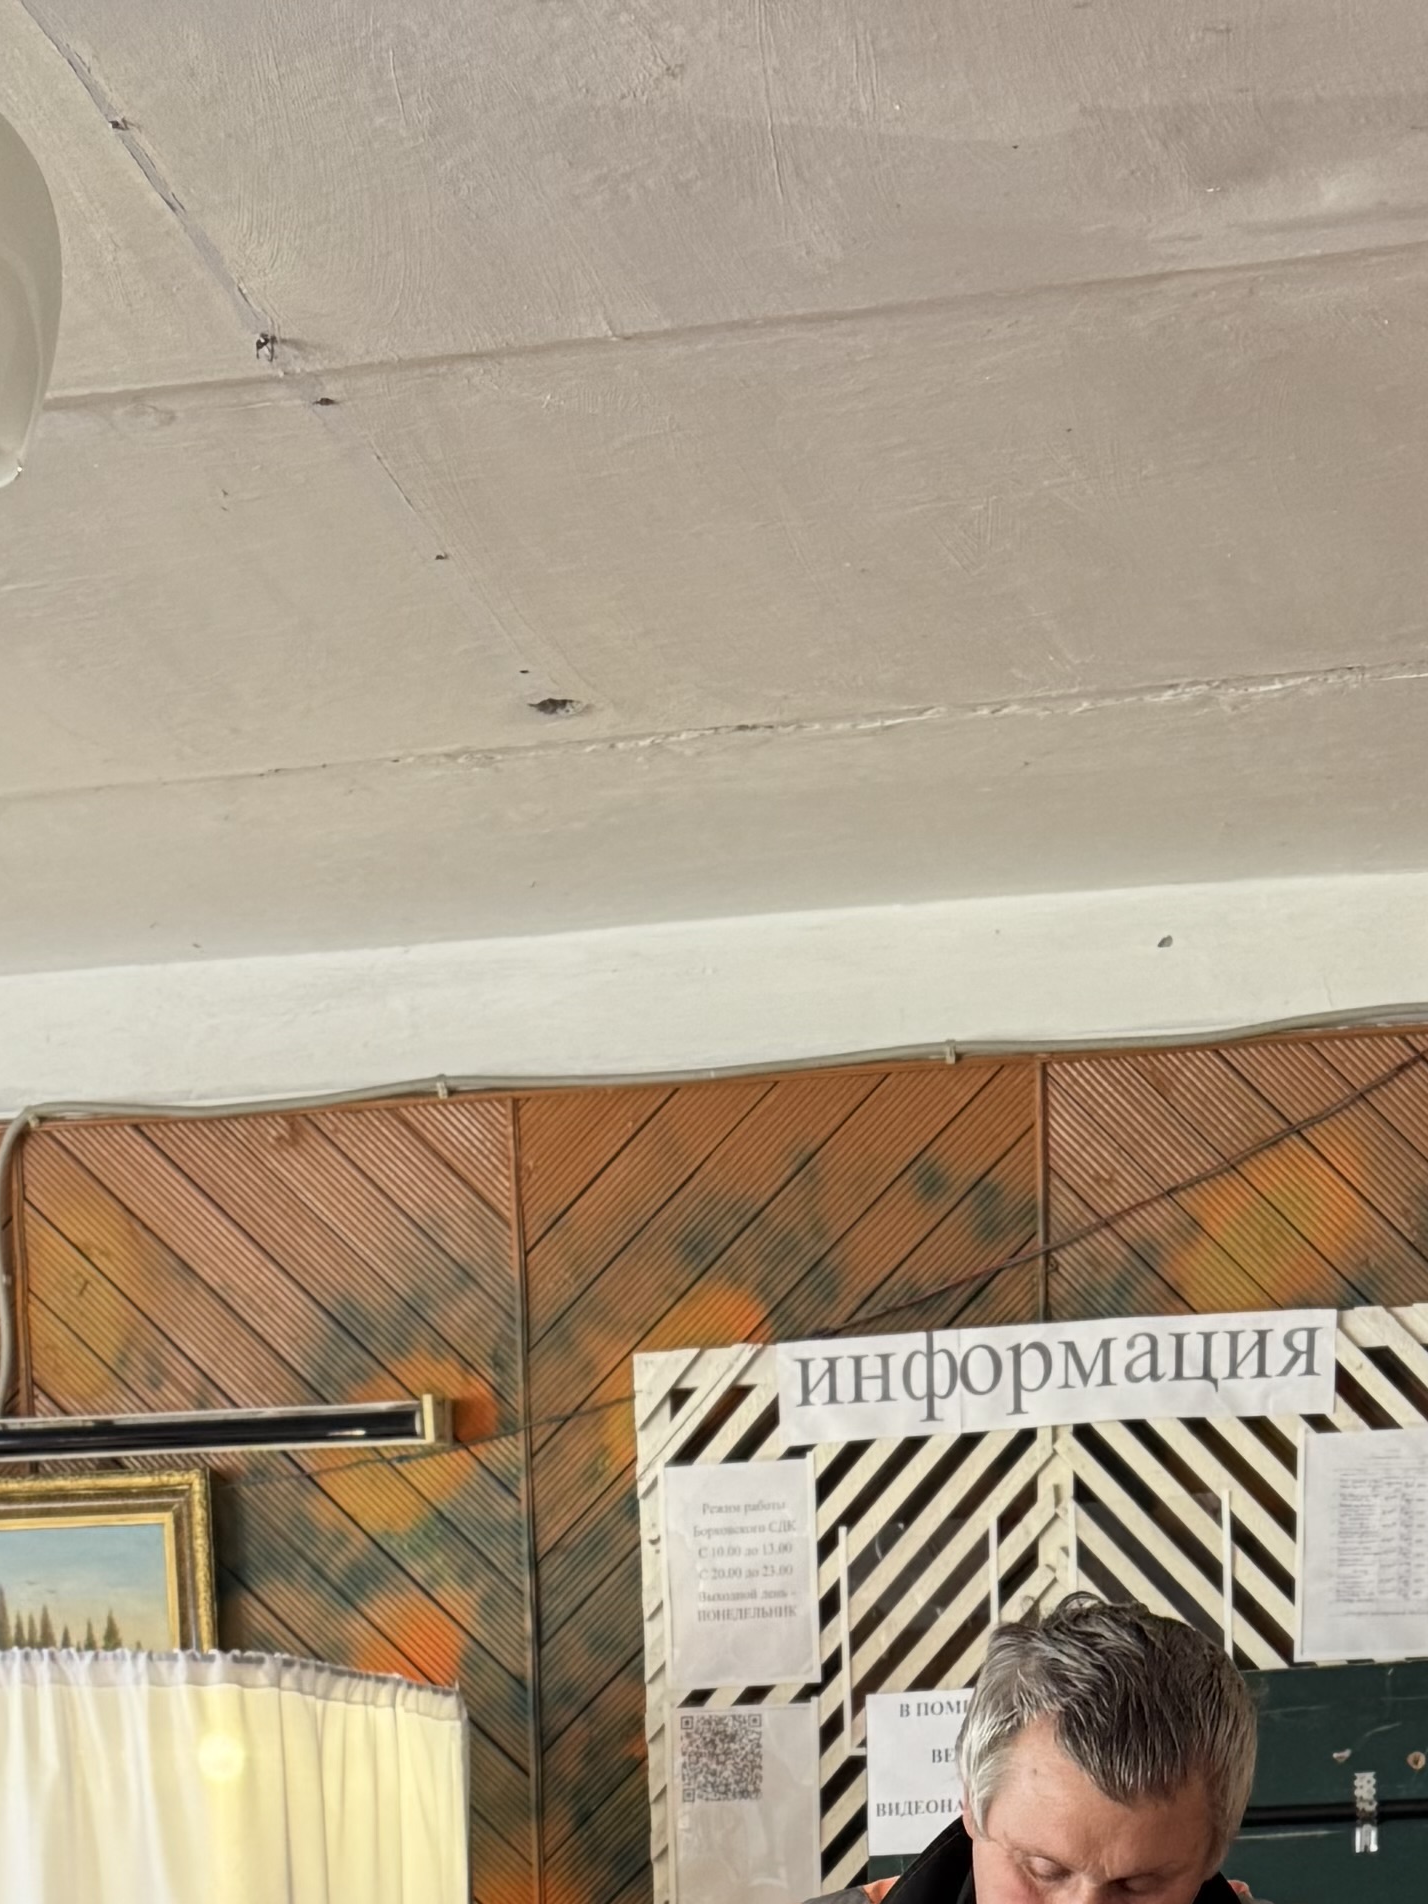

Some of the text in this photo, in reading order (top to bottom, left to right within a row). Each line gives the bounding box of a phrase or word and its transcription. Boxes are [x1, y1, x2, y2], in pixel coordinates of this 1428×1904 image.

[793, 1326, 1324, 1423] информация
[744, 1499, 786, 1515] работы
[768, 1519, 796, 1533] СДК
[698, 1605, 797, 1622] ПОНЕДЕЛЬНИК
[899, 1699, 968, 1718] В ПОМ
[932, 1748, 957, 1763] ВЕ
[876, 1798, 964, 1817] ВИДЕОНА
